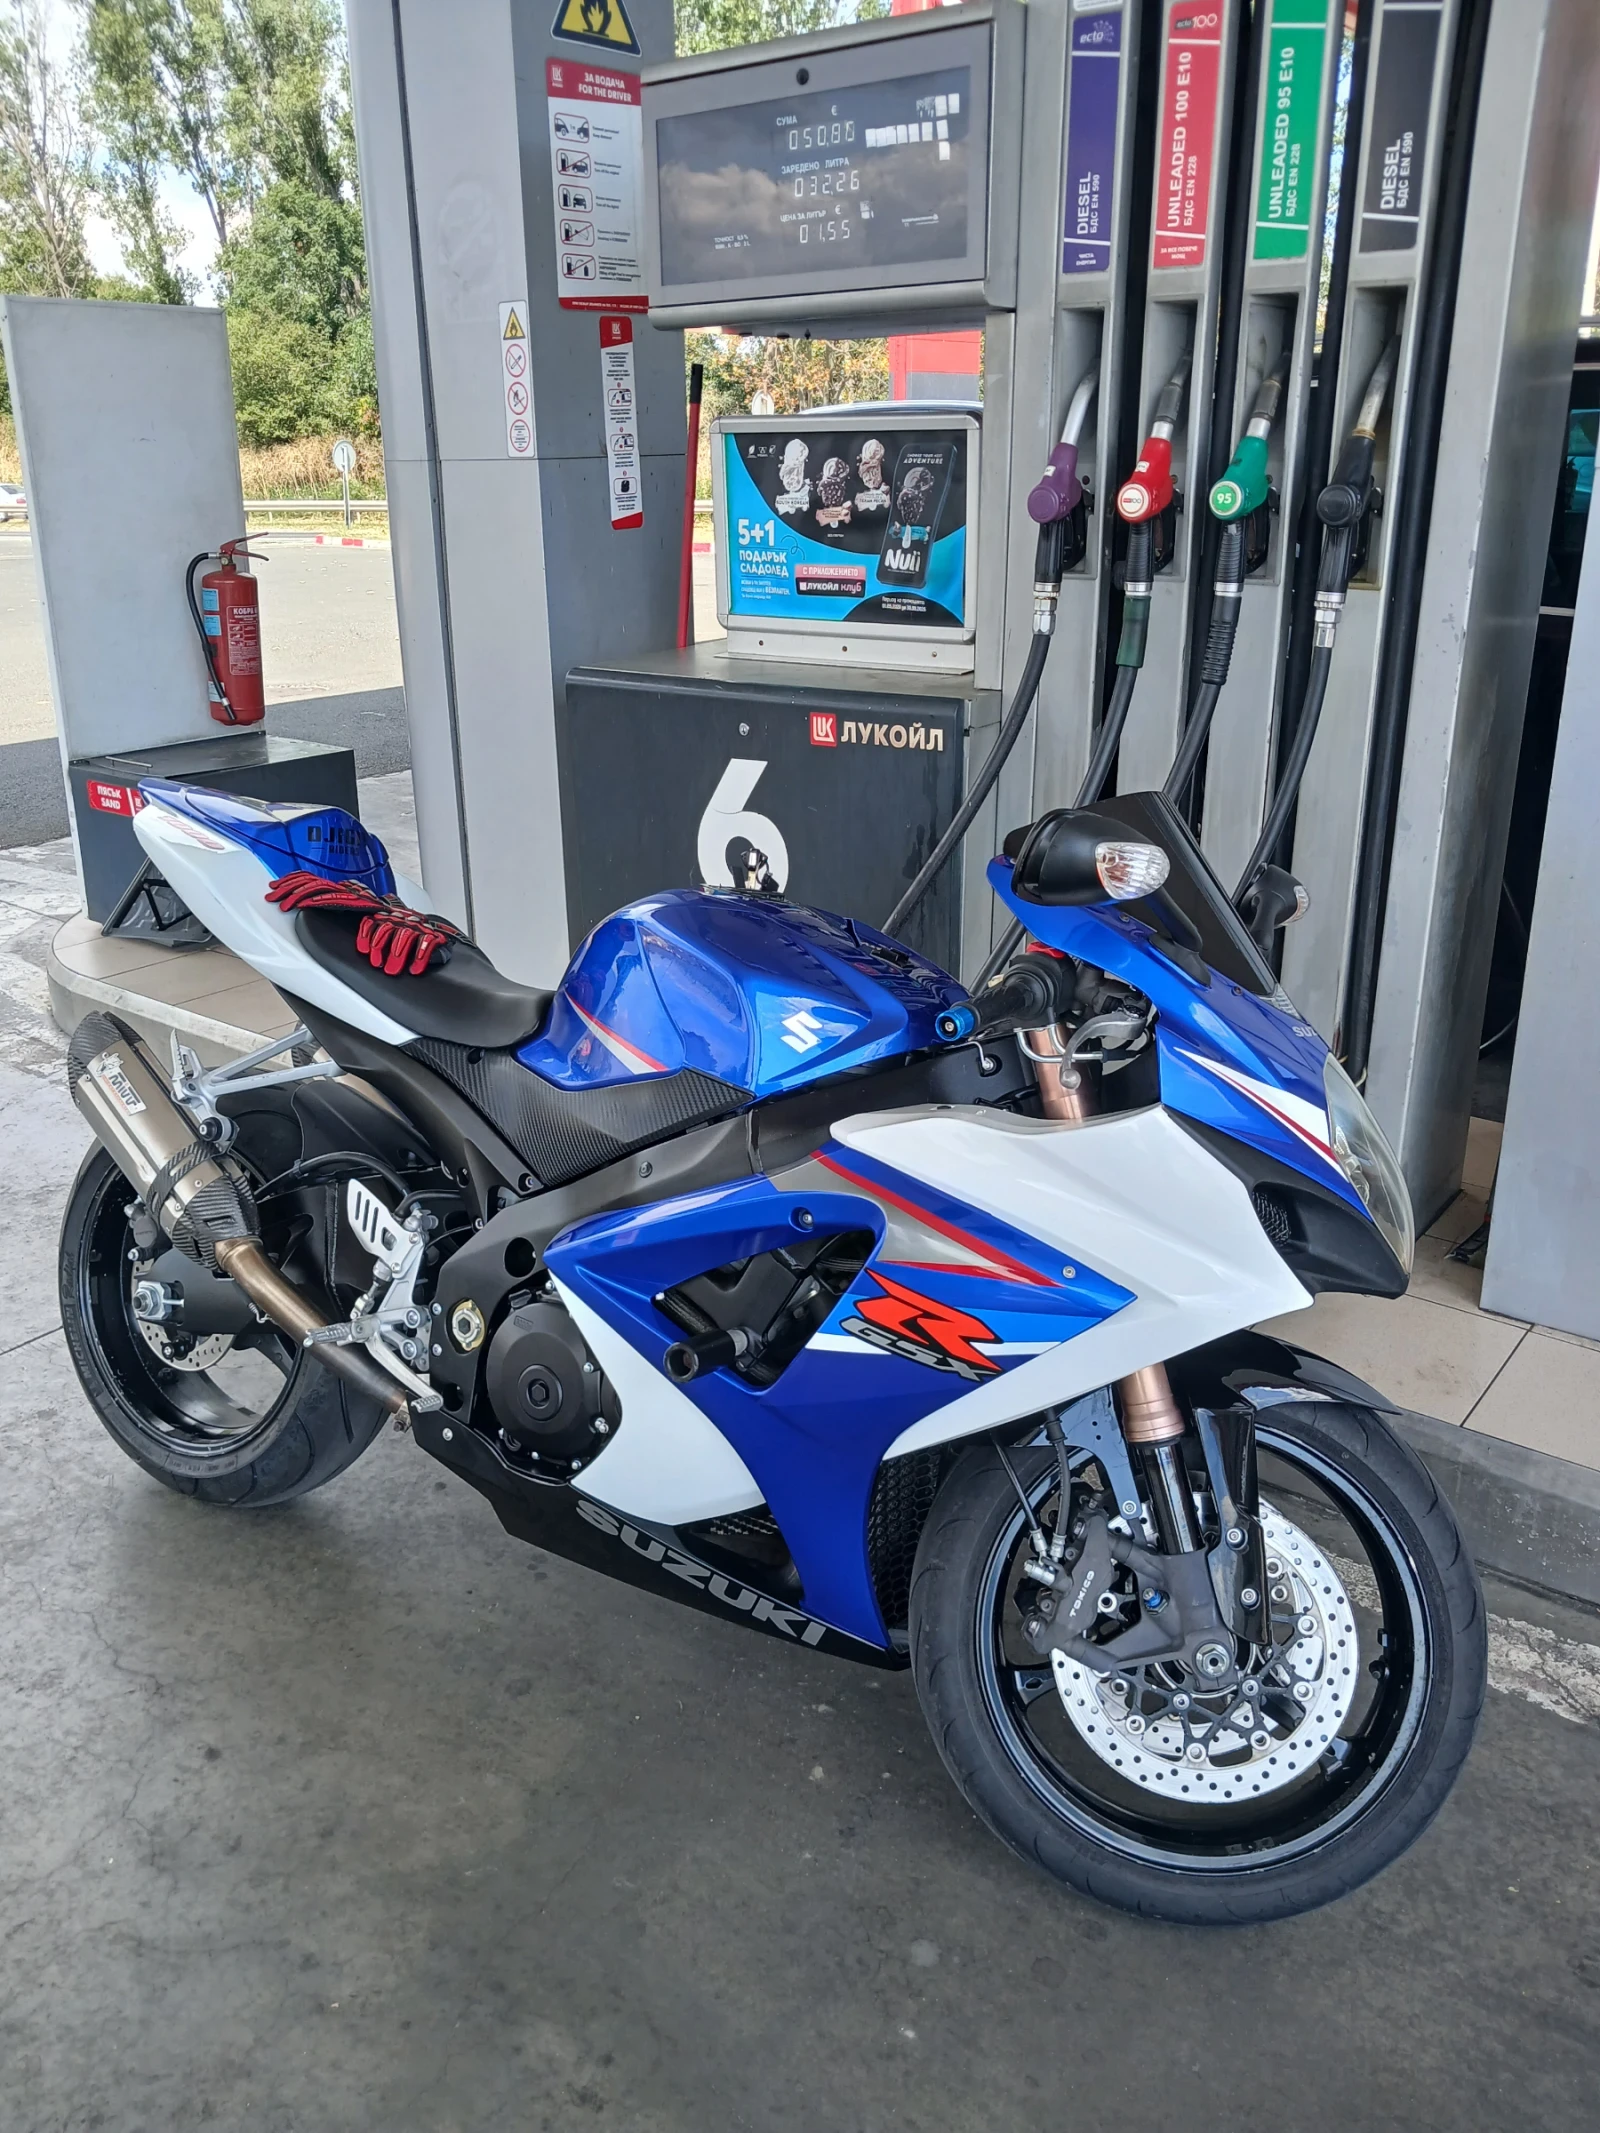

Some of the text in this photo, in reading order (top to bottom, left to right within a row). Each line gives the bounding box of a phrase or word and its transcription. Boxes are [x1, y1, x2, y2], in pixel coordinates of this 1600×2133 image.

[1080, 30, 1104, 44] ecto
[584, 72, 625, 89] ЗА ВОДАЧА
[578, 84, 632, 102] FOR THE DRIVER
[776, 115, 798, 126] СУМА
[1167, 52, 1192, 228] UNLEADED 100 E10
[1268, 47, 1295, 219] UNLEADED 95 E10
[781, 157, 850, 175] ЗАРЕДЕНО ЛИТРА
[1380, 139, 1401, 209] DIESEL
[1396, 131, 1414, 209] БДС EN 590
[1289, 168, 1299, 186] EN
[1184, 155, 1198, 226] БДС EN 228
[1077, 171, 1091, 234] DIESEL
[1090, 174, 1100, 233] БДС EN 590
[1286, 189, 1298, 217] БДС
[780, 212, 797, 222] ЦЕНА
[797, 212, 805, 220] ЗА
[806, 210, 827, 219] ЛИТЪР
[1217, 493, 1232, 505] 95
[738, 518, 775, 547] 5+1
[739, 550, 787, 563] ПОДАРЪК
[740, 563, 789, 578] СЛАДОЛЕД
[802, 566, 859, 577] С ПРИЛОЖЕНИЕТО
[807, 581, 862, 594] ЛУКОЙЛ клуб
[841, 721, 943, 751] ЛУКОЙЛ
[97, 785, 122, 799] ПЯСЪК
[101, 797, 121, 809] SAND
[697, 758, 789, 893] 6
[576, 1500, 826, 1646] SUZUKI
[1069, 1570, 1095, 1617] TOKICO
